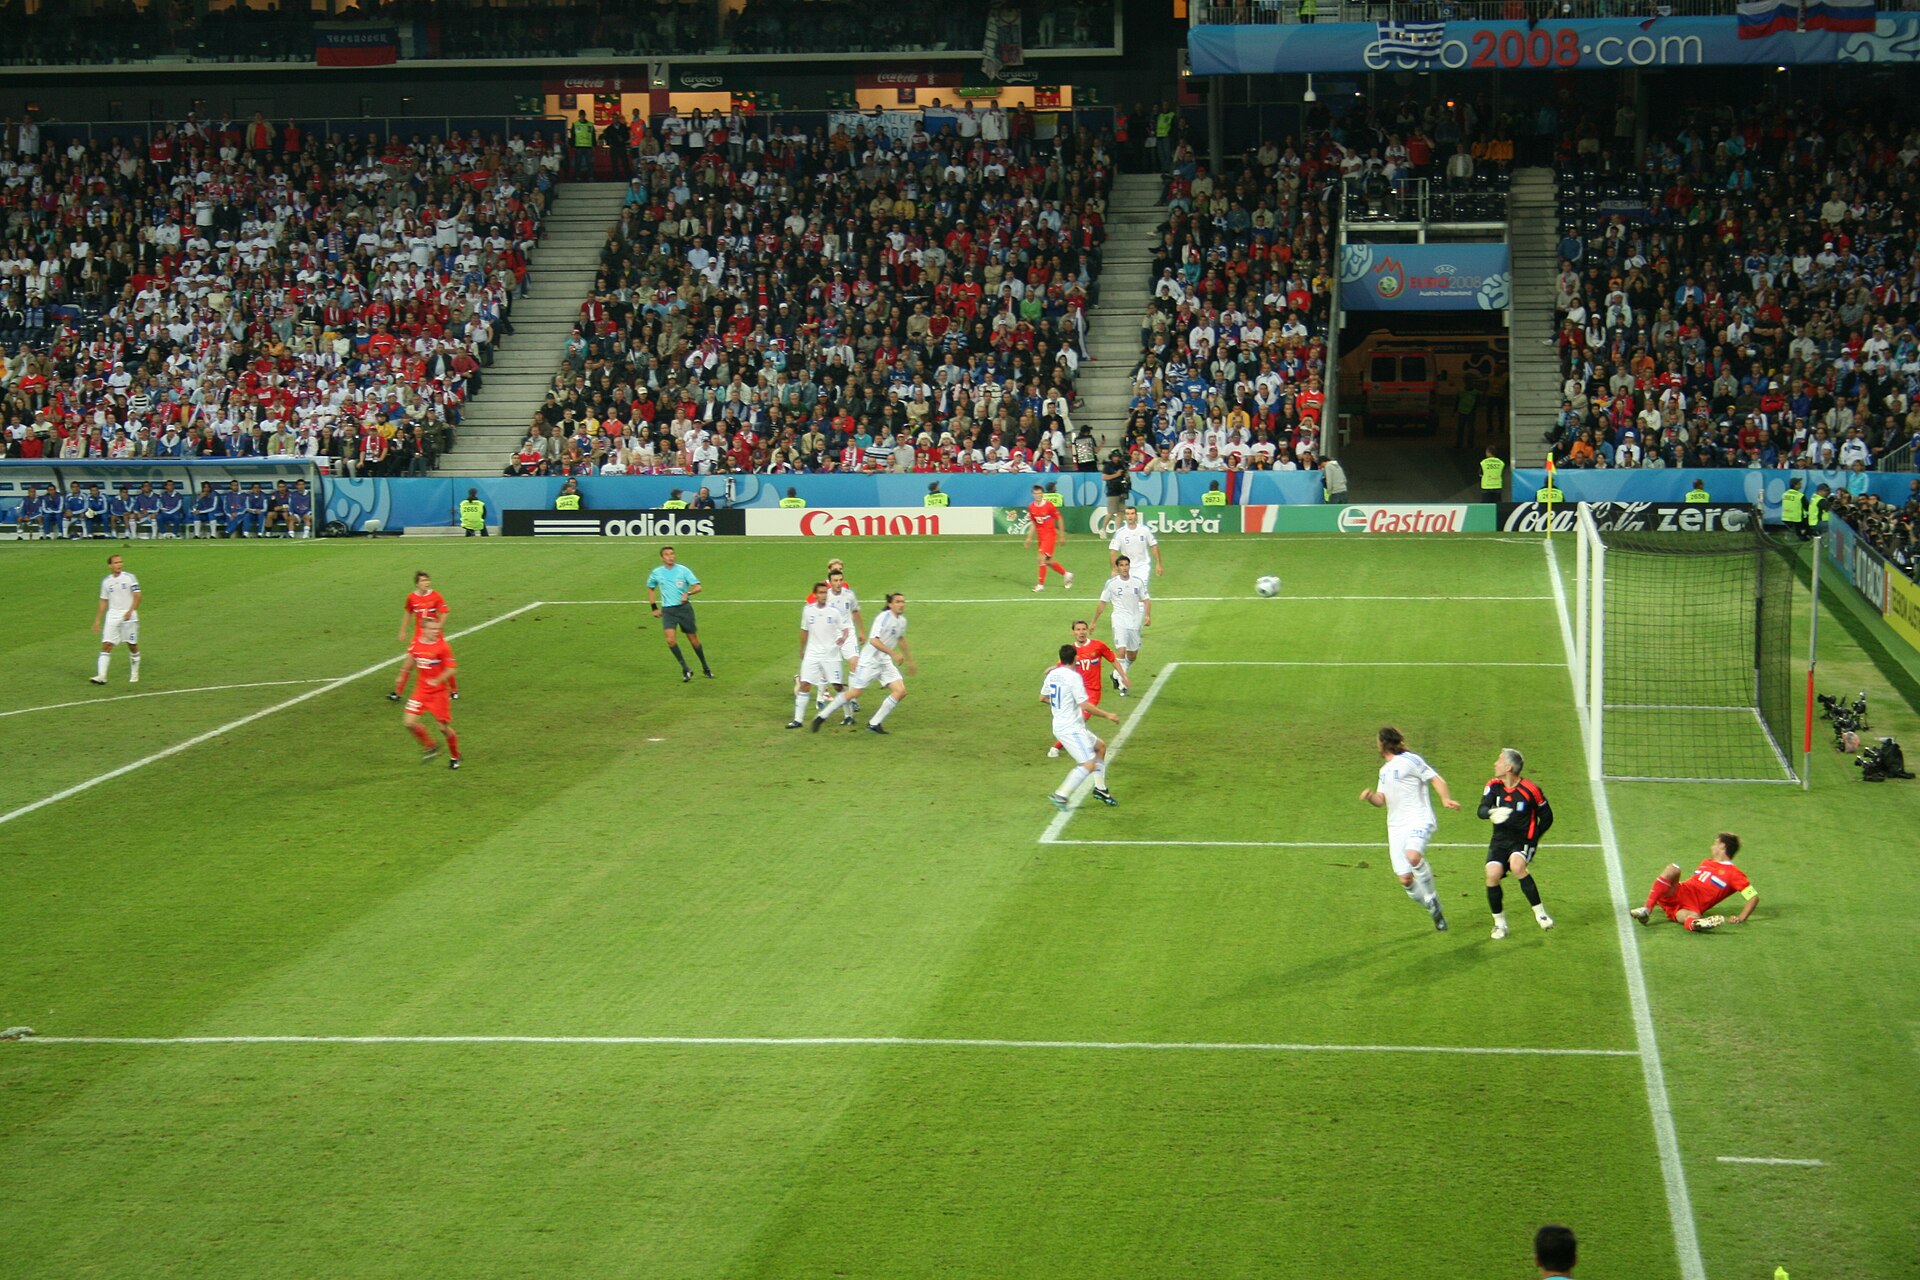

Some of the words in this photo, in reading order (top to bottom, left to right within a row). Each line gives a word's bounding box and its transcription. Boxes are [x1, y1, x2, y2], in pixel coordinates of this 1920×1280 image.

[654, 63, 663, 76] 7
[680, 72, 724, 86] Carlsberg
[605, 513, 715, 536] adidas
[800, 510, 939, 536] Canon
[1368, 509, 1457, 532] Castrol
[1657, 508, 1745, 532] zero
[1124, 536, 1130, 544] 5
[1117, 587, 1123, 596] 2
[1080, 659, 1090, 671] 17
[1049, 683, 1061, 709] 21
[1698, 870, 1712, 883] 11
